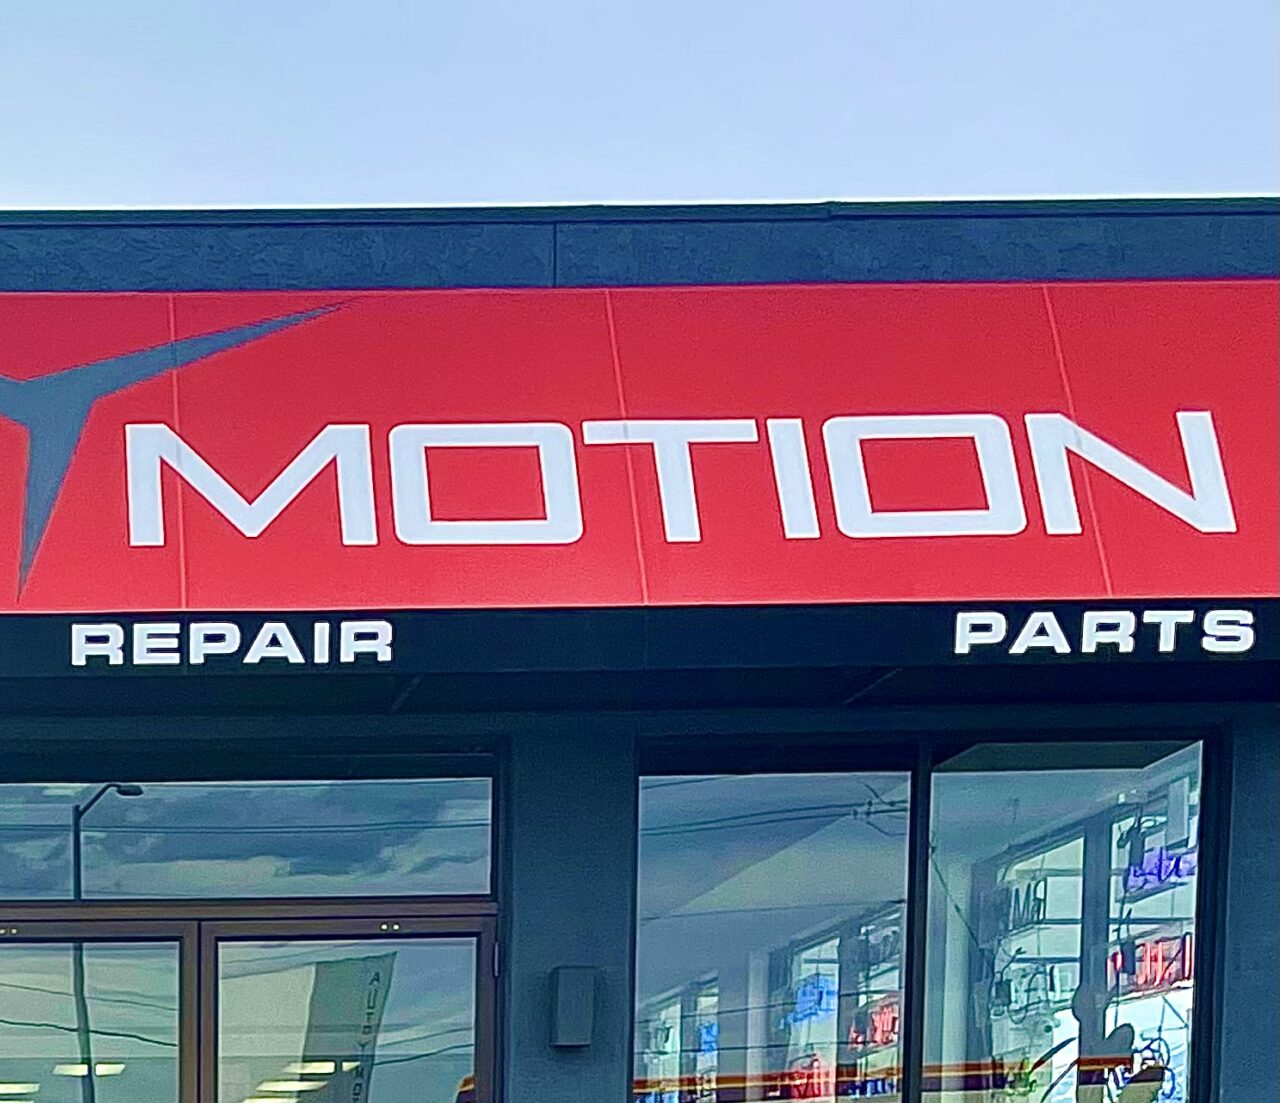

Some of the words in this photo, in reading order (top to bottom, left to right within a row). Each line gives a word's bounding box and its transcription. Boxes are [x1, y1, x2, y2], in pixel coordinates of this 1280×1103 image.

[124, 410, 1238, 547] MOTION
[70, 621, 395, 666] REPAIR
[953, 608, 1257, 656] PARTS
